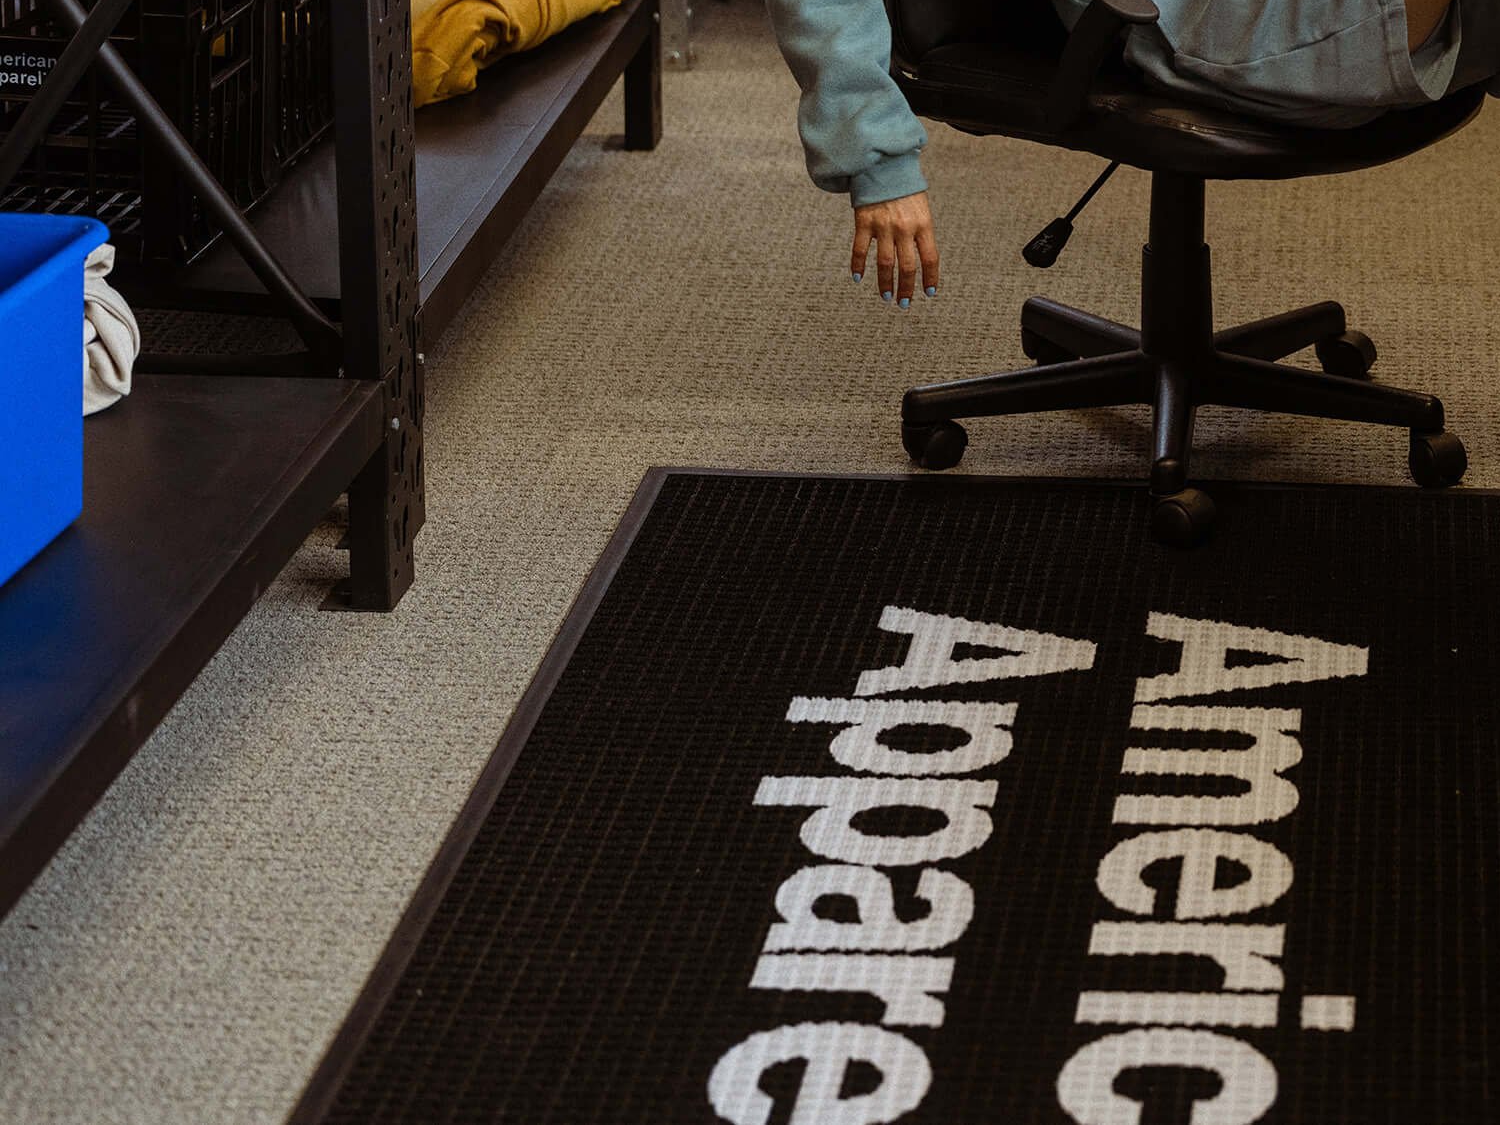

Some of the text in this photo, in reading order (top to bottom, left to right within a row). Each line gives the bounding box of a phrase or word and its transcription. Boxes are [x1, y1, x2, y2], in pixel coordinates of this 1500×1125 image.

[0, 53, 57, 68] erican
[707, 605, 1098, 1125] Appare
[1055, 611, 1370, 1125] Americ
